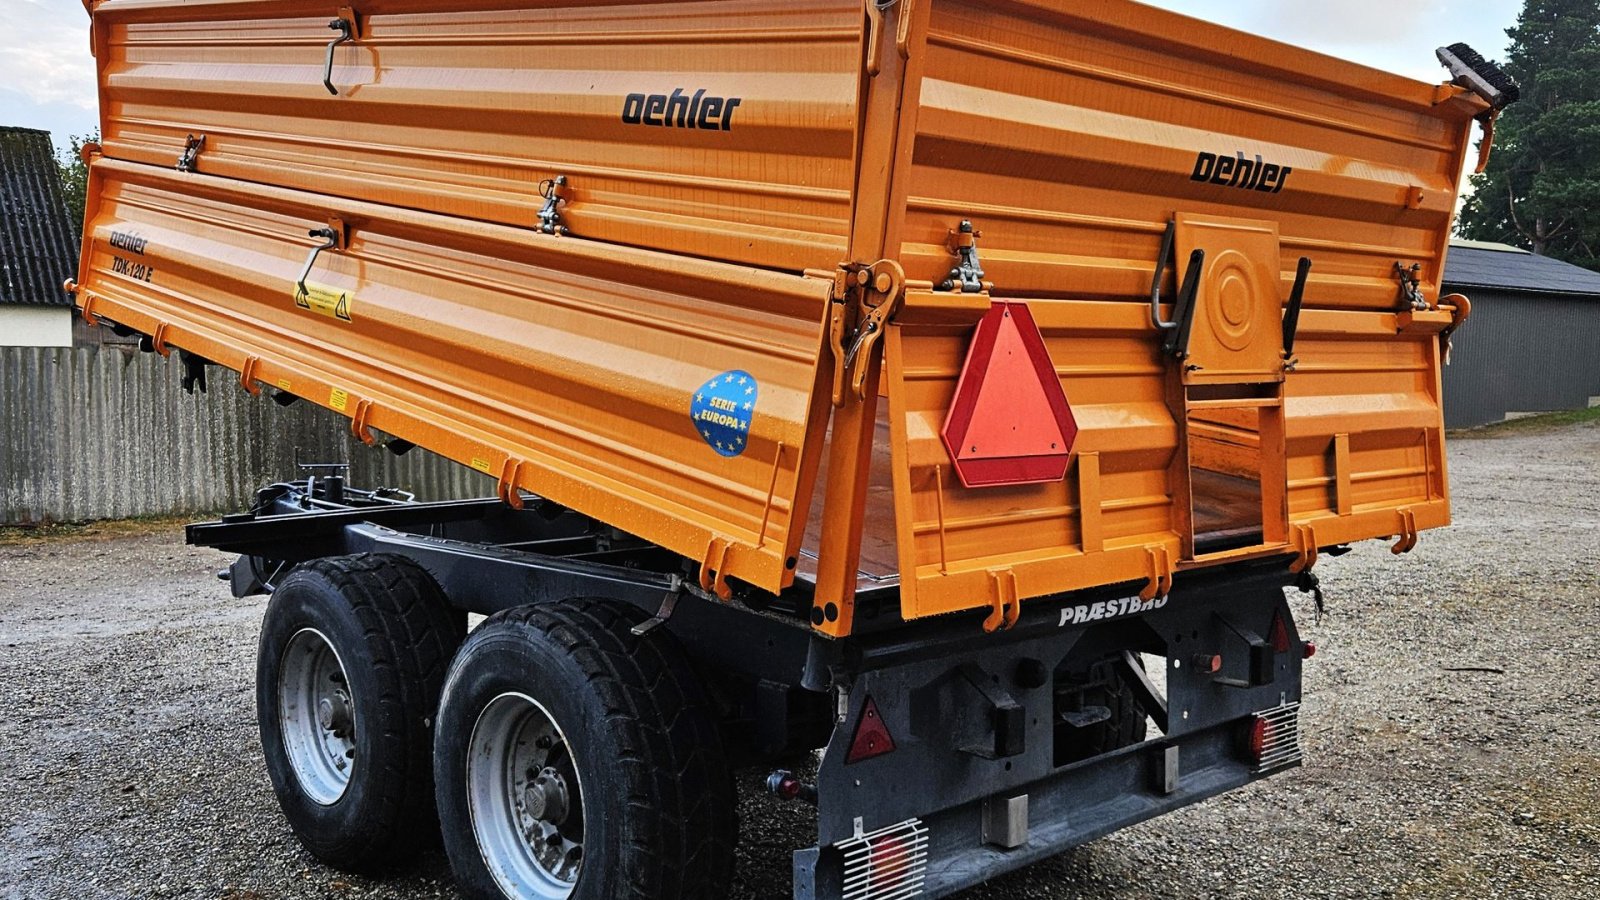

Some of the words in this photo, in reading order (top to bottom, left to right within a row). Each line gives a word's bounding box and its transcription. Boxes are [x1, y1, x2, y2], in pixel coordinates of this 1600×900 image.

[622, 88, 741, 131] oehler
[1190, 151, 1292, 193] oehler
[145, 267, 154, 283] E
[709, 397, 737, 412] SERIE
[701, 409, 738, 429] EUROPA
